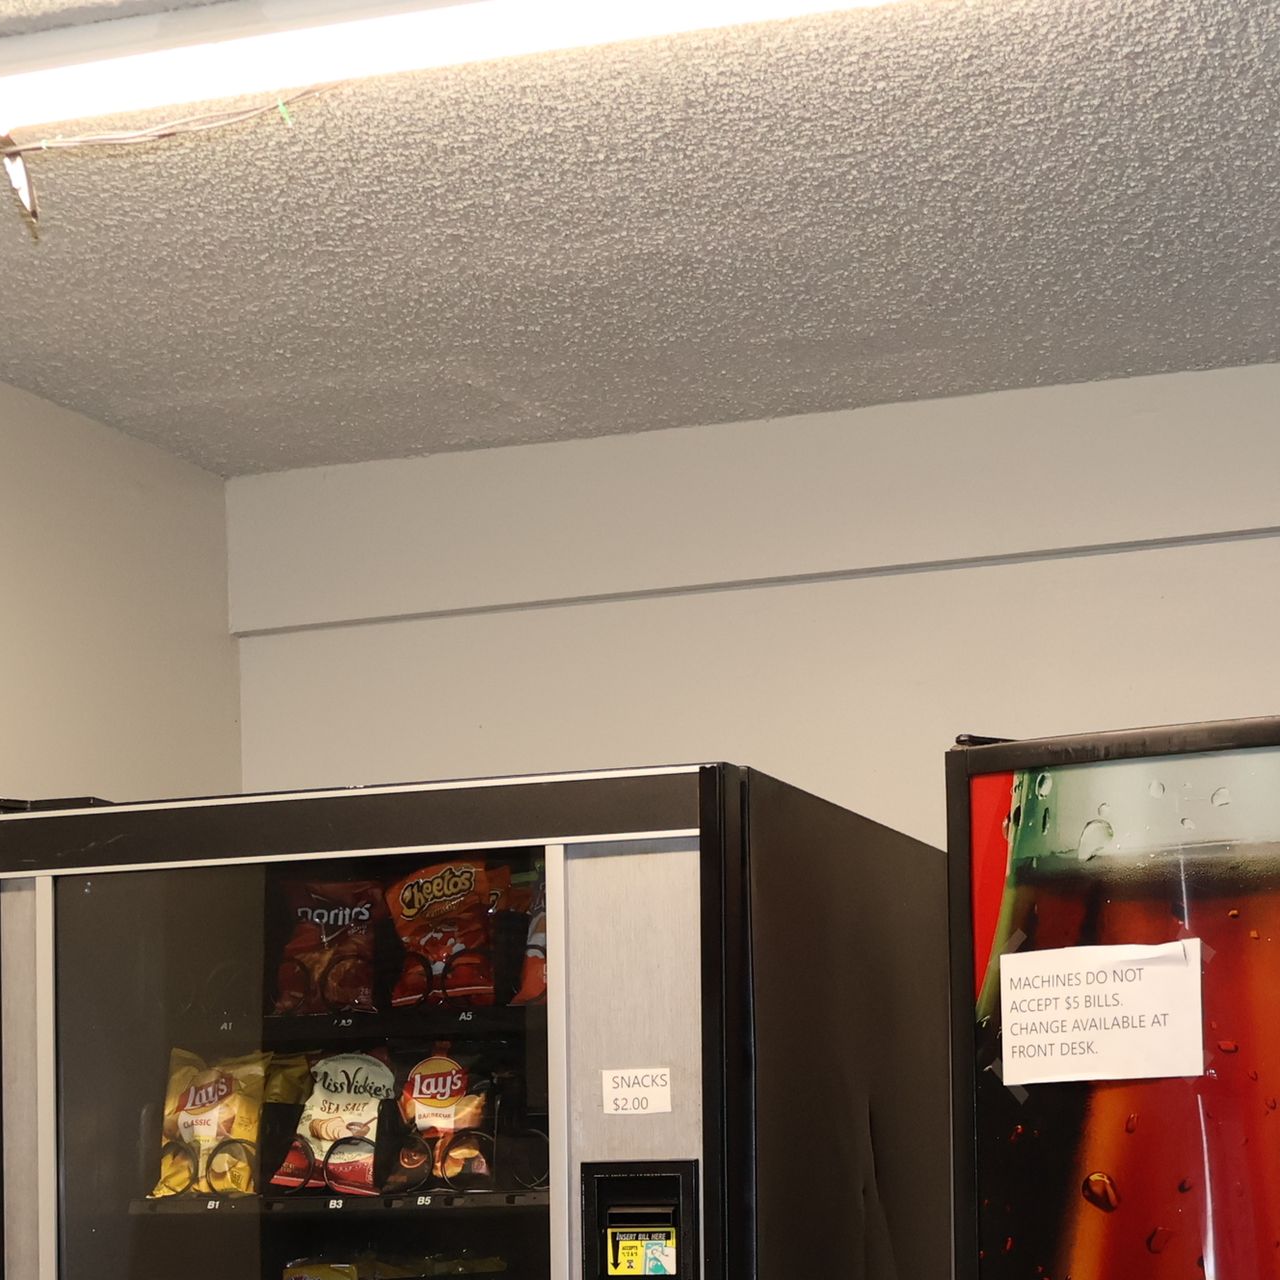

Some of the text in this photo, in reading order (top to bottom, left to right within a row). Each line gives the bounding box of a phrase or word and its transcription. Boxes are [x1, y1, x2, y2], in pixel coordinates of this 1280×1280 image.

[1010, 968, 1144, 990] MACHINES DO NOT
[1010, 993, 1123, 1013] ACCEPT $5 BILLS.
[459, 1012, 472, 1021] A5
[1010, 1014, 1168, 1036] CHANGE AVAILABLE AT
[1011, 1041, 1098, 1058] FRONT DESK.
[340, 1067, 393, 1097] Vickie's
[413, 1070, 462, 1100] Lay's
[612, 1074, 668, 1089] SNACKS
[321, 1100, 369, 1114] SEA SALT
[613, 1097, 648, 1111] $2.00
[183, 1118, 211, 1129] CLASSIC
[207, 1201, 220, 1209] B1
[329, 1200, 343, 1209] B3
[417, 1196, 431, 1205] B5
